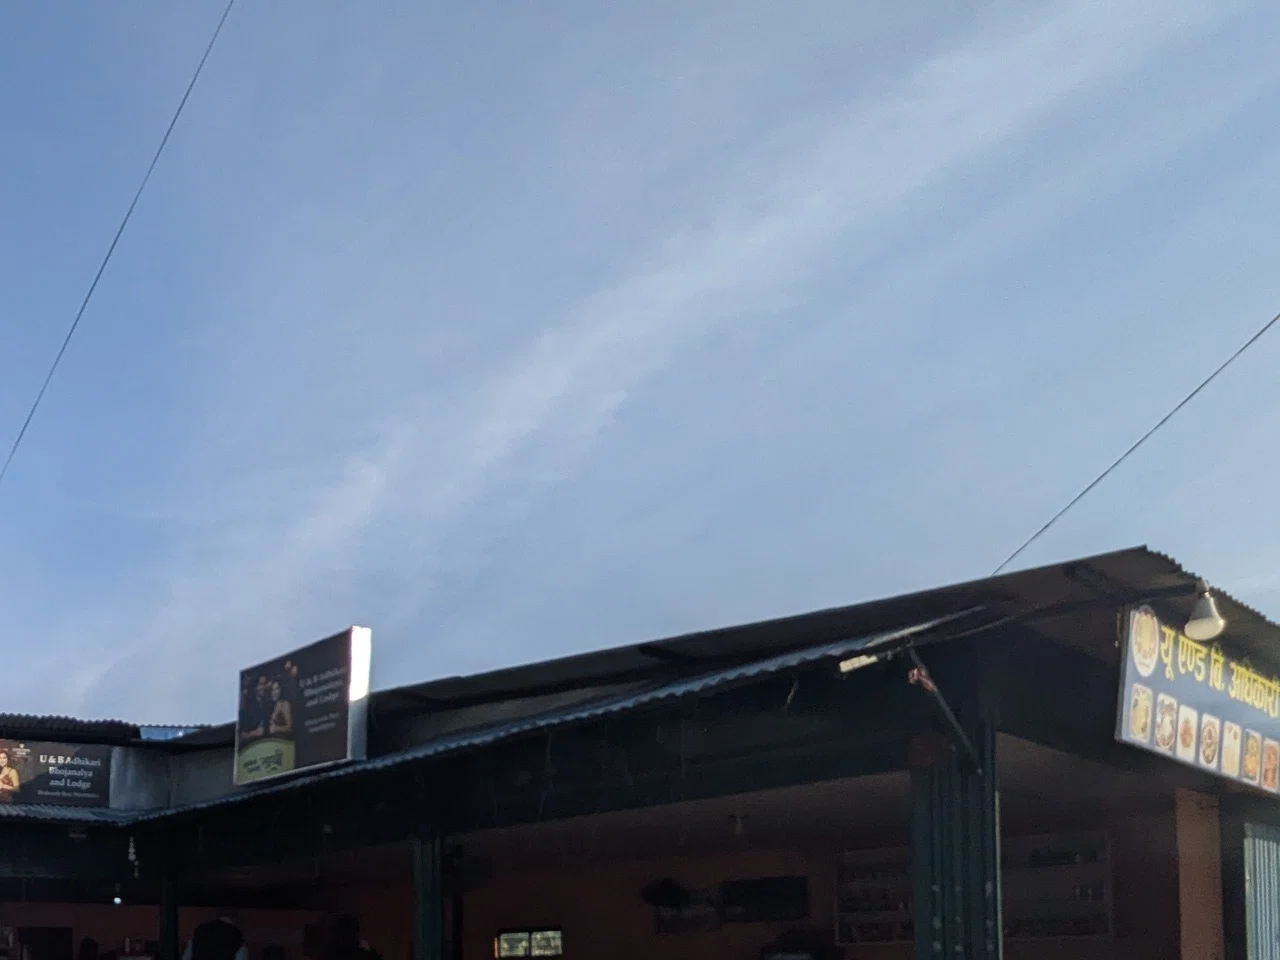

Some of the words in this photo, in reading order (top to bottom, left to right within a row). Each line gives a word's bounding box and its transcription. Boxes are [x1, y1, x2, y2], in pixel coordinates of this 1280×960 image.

[39, 754, 48, 763] U
[48, 755, 56, 764] &
[57, 755, 65, 764] B
[49, 778, 65, 787] and
[66, 778, 92, 790] Lodge
